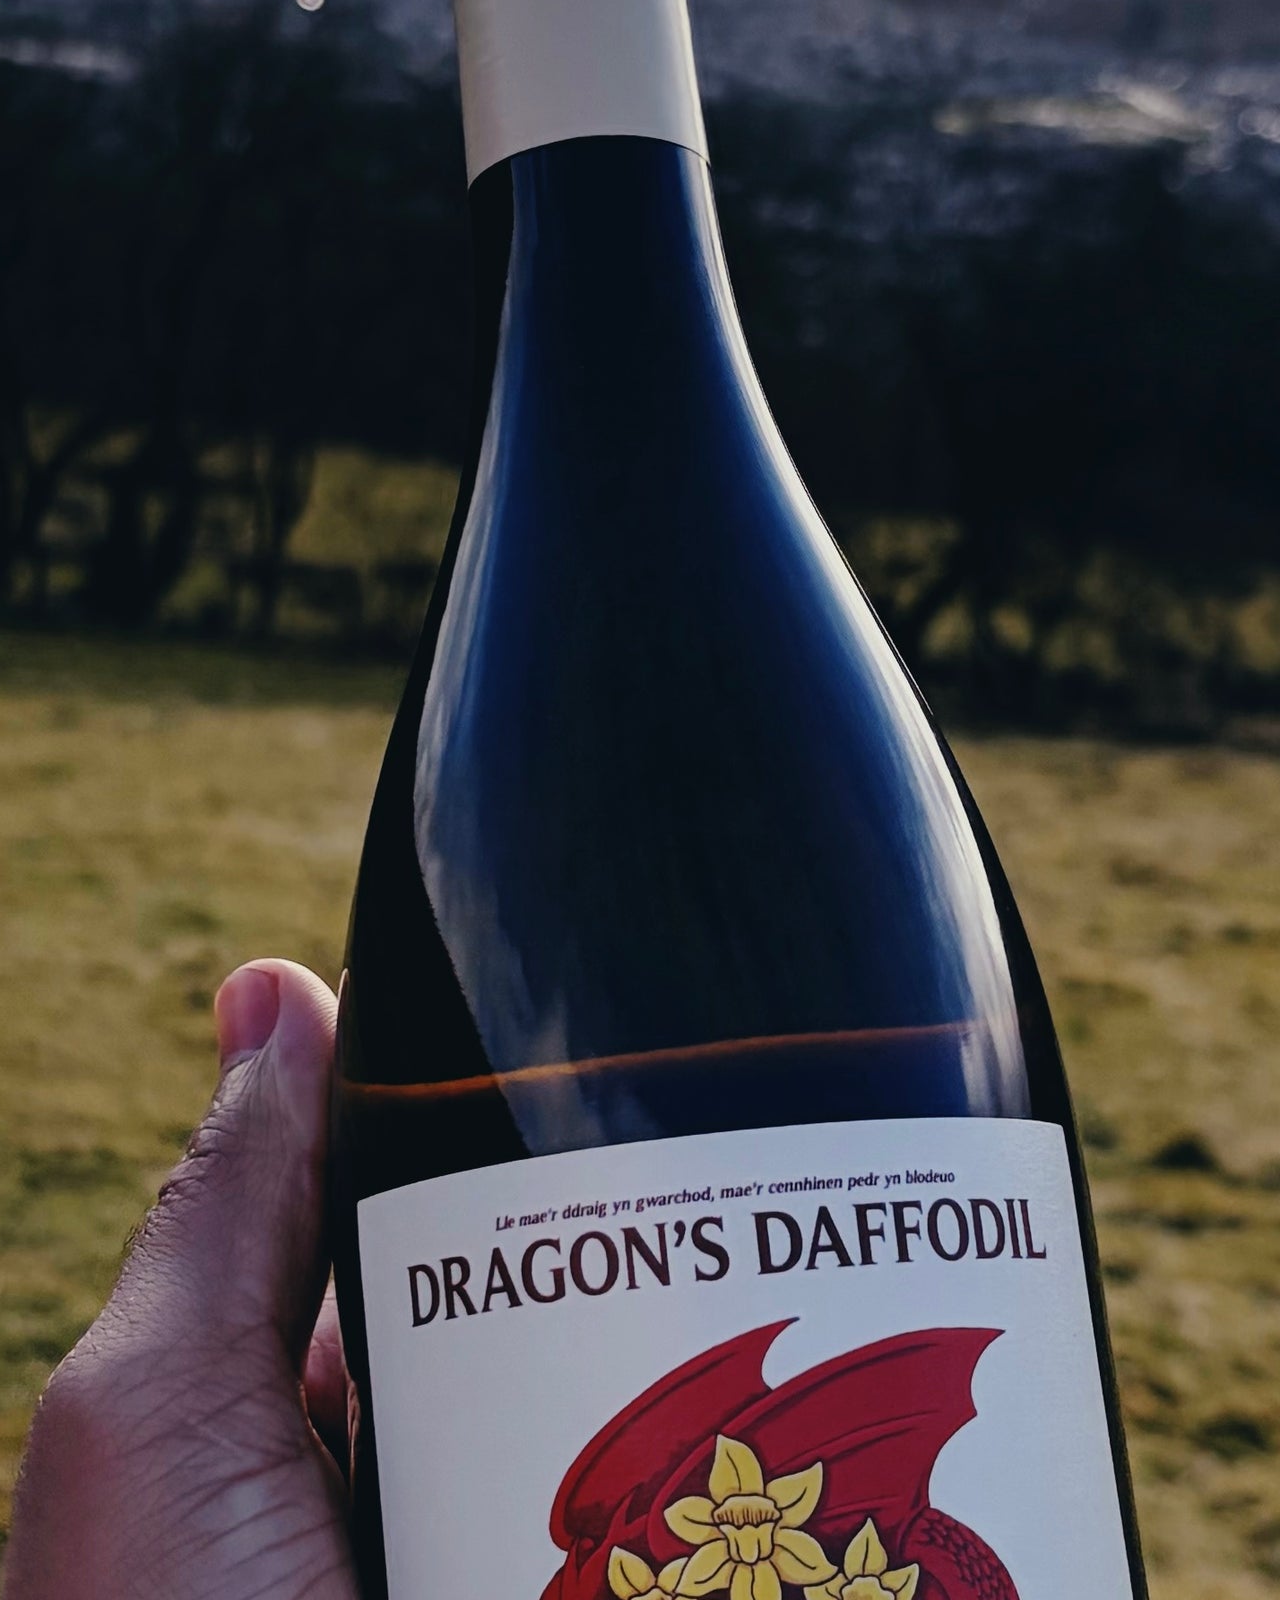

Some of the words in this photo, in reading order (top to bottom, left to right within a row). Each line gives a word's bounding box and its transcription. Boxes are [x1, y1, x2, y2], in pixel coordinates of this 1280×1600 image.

[519, 1208, 558, 1227] mae'r
[562, 1201, 608, 1220] ddraig
[612, 1199, 631, 1216] yn
[635, 1186, 715, 1213] gwarchod,
[719, 1181, 764, 1199] mae'r
[768, 1176, 843, 1195] cennhinen
[847, 1172, 880, 1191] pedr
[884, 1173, 901, 1189] yn
[905, 1169, 955, 1184] blodeuo
[406, 1215, 731, 1328] DRAGON'S
[752, 1197, 1047, 1275] DAFFODIL
